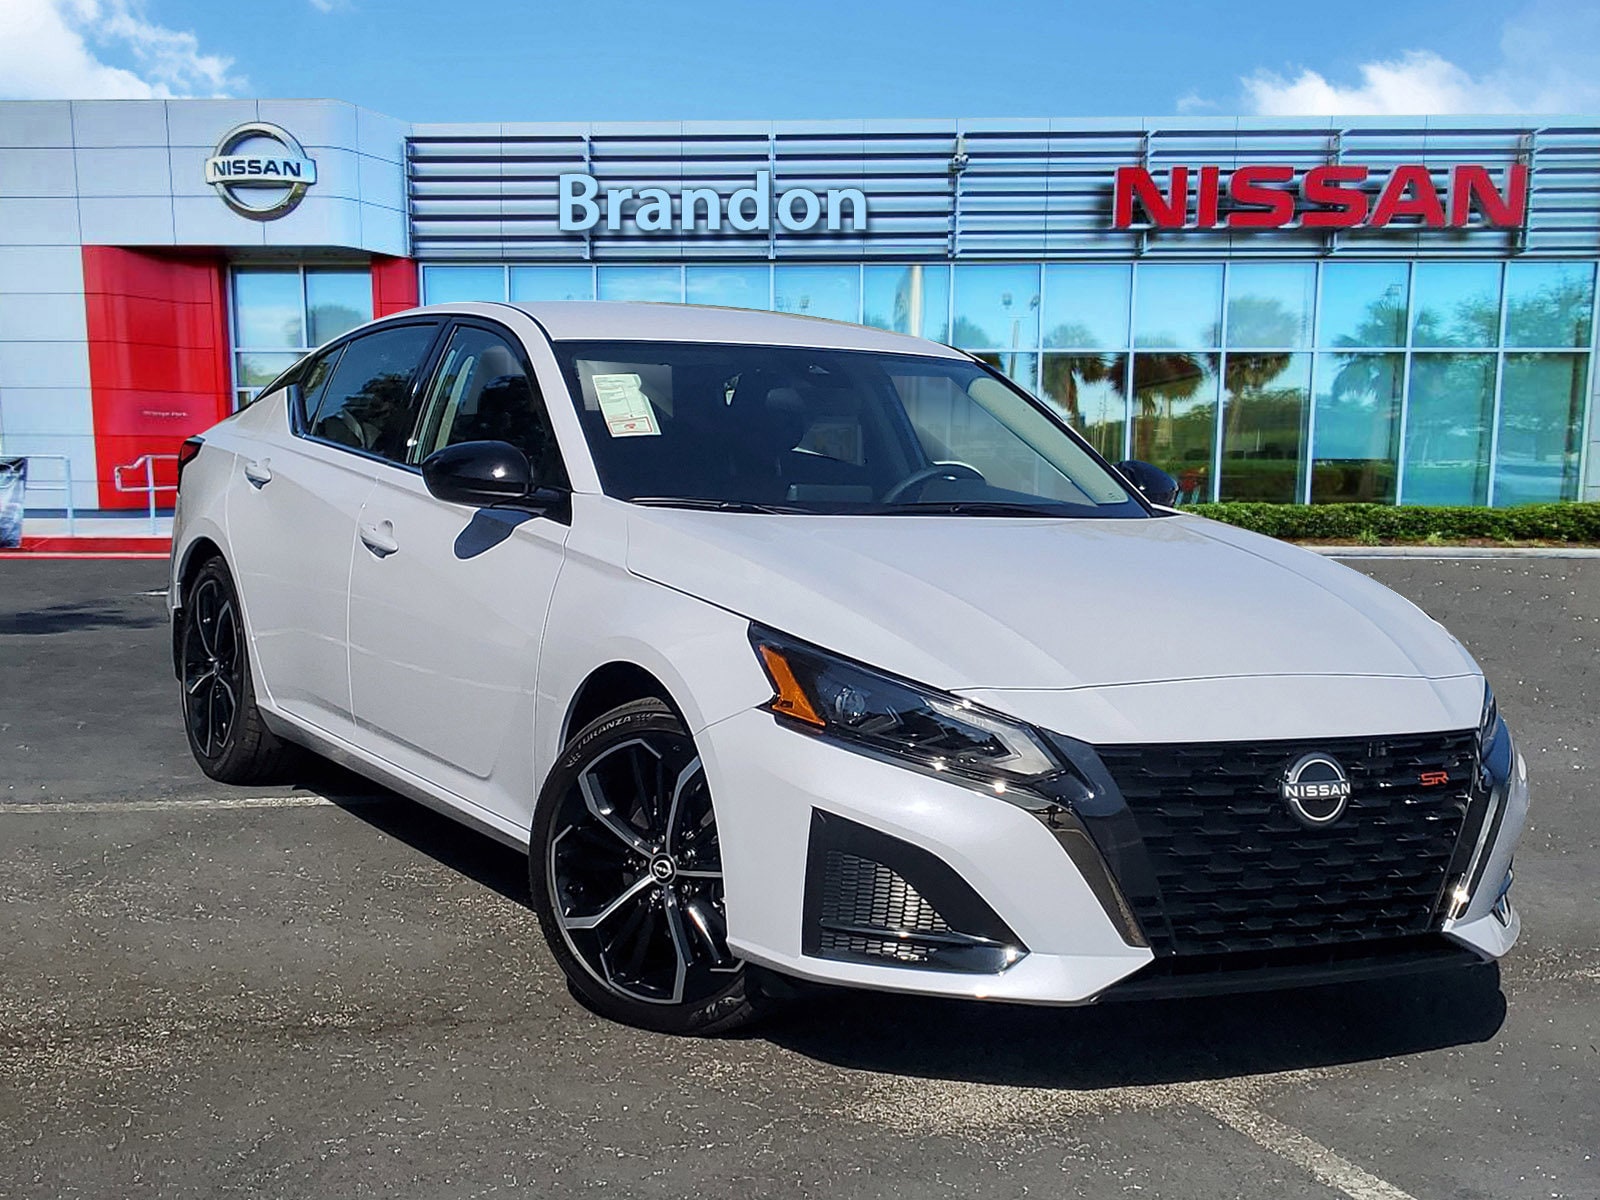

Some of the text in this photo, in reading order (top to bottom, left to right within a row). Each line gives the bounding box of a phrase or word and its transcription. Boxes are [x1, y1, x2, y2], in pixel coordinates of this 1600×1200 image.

[213, 160, 301, 177] NISSAN
[559, 171, 867, 231] Brandon
[1112, 165, 1528, 229] NISSAN
[1420, 771, 1448, 786] SR
[1285, 782, 1350, 798] NISSAN
